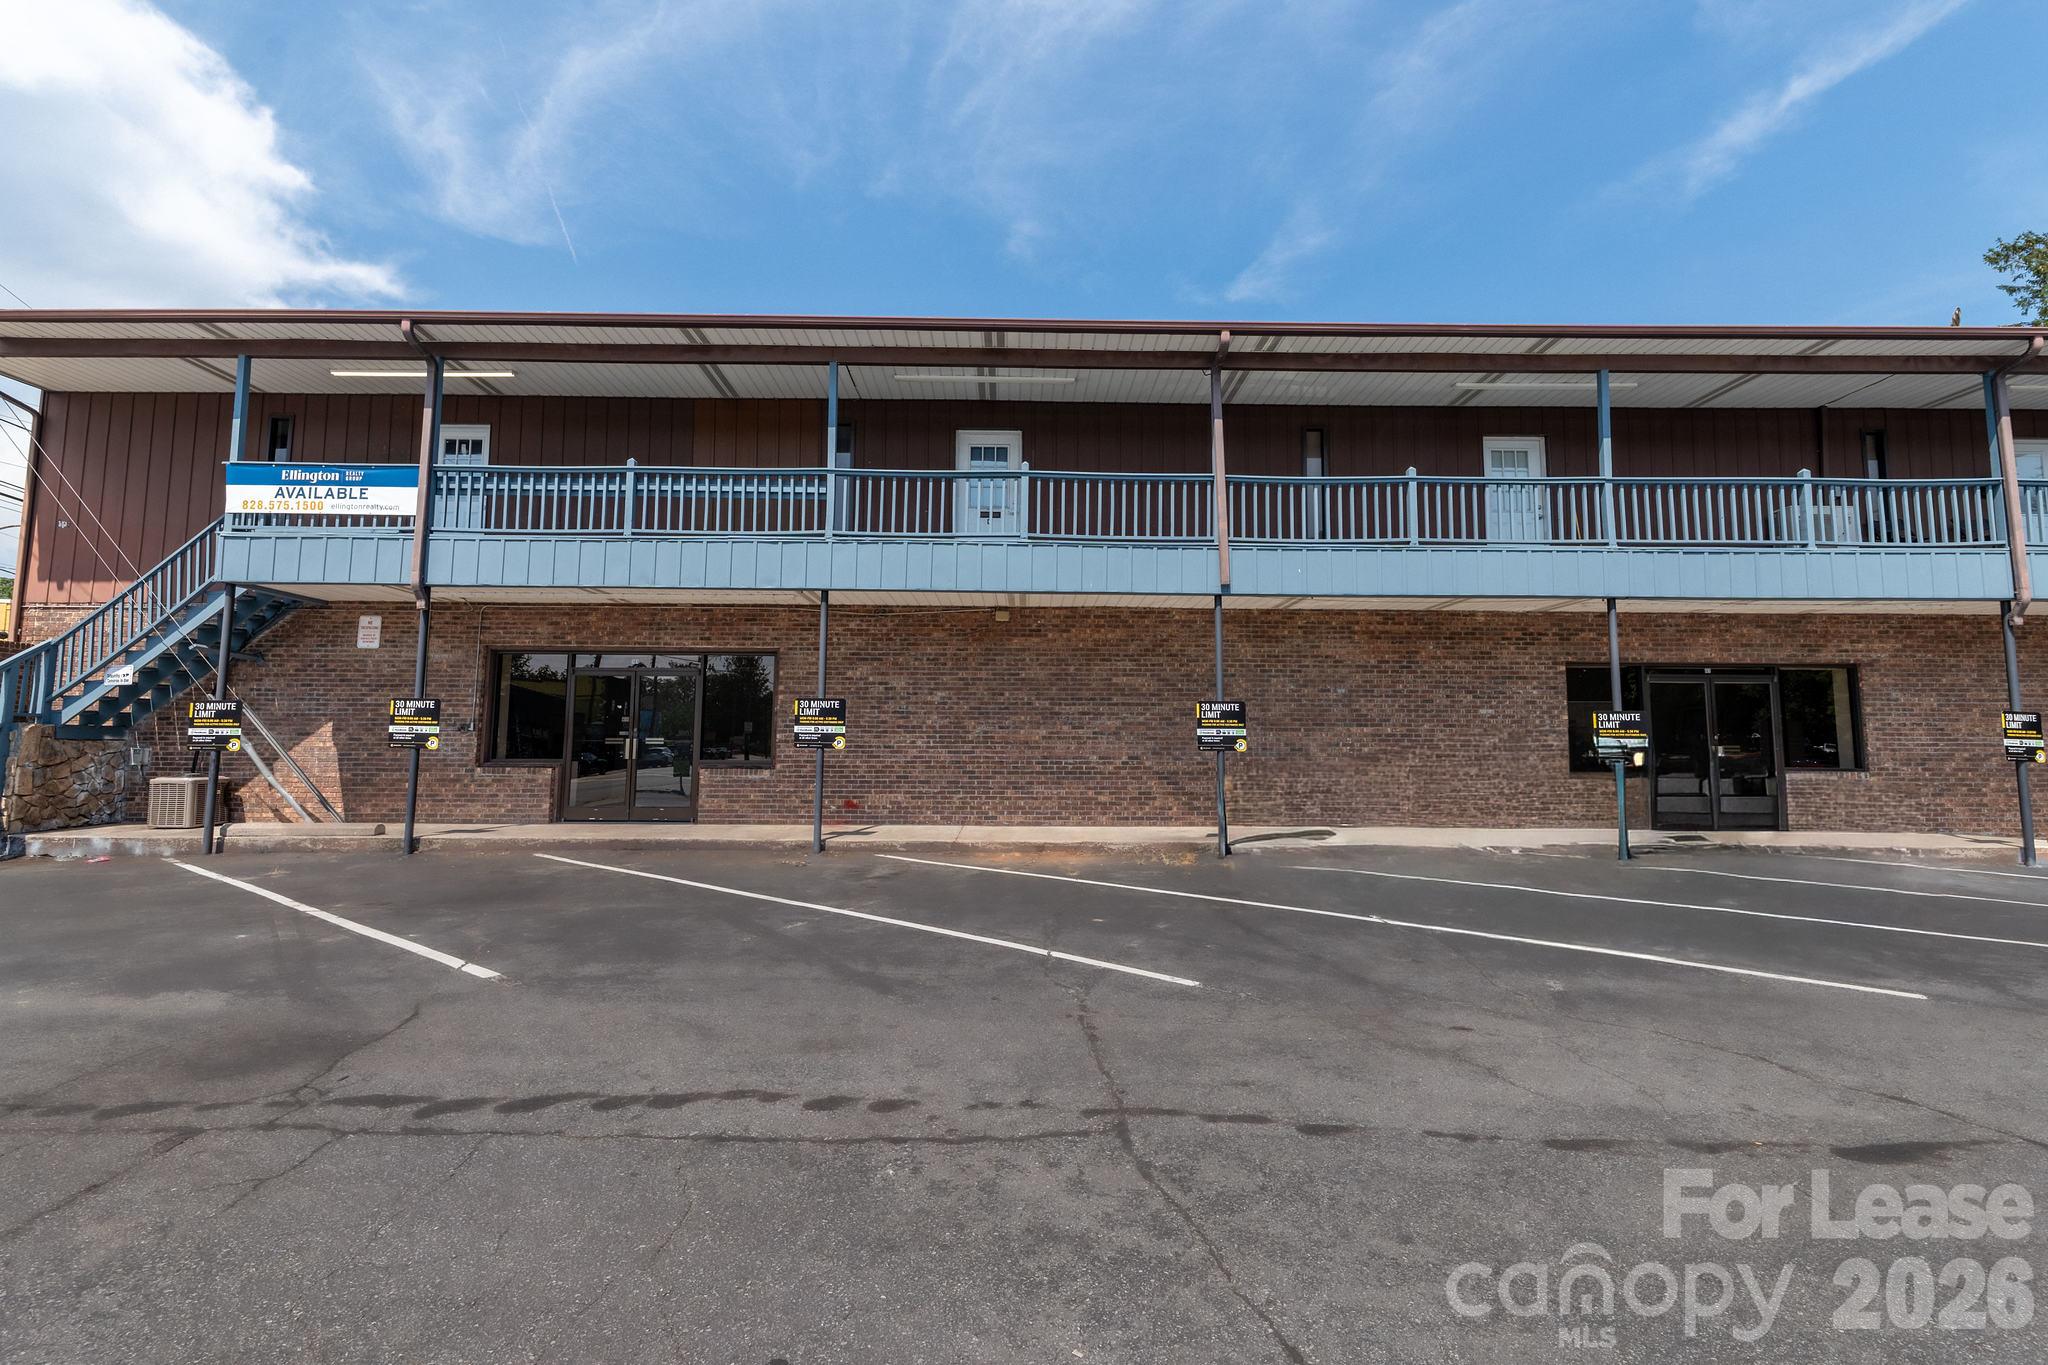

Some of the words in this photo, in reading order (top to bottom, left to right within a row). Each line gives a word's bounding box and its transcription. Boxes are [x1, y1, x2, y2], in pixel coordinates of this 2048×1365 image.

[281, 469, 339, 483] Ellington
[274, 486, 369, 500] AVAILABLE
[242, 500, 324, 511] 828.575.1500
[331, 503, 400, 512] ellingtonrealty.com
[194, 702, 205, 710] 30
[206, 702, 236, 710] MINUTE
[395, 700, 405, 708] 30
[406, 700, 435, 709] MINUTE
[799, 700, 809, 708] 30
[810, 700, 840, 709] MINUTE
[1200, 703, 1210, 711] 30
[1211, 703, 1240, 711] MINUTE
[194, 710, 216, 718] LIMIT
[394, 708, 415, 716] LIMIT
[799, 708, 820, 716] LIMIT
[1201, 711, 1221, 719] LIMIT
[1597, 713, 1608, 721] 30
[1610, 713, 1640, 721] MINUTE
[2005, 713, 2013, 721] 30
[2013, 713, 2037, 722] MINUTE
[1598, 721, 1620, 729] LIMIT
[2006, 721, 2023, 729] LIMIT
